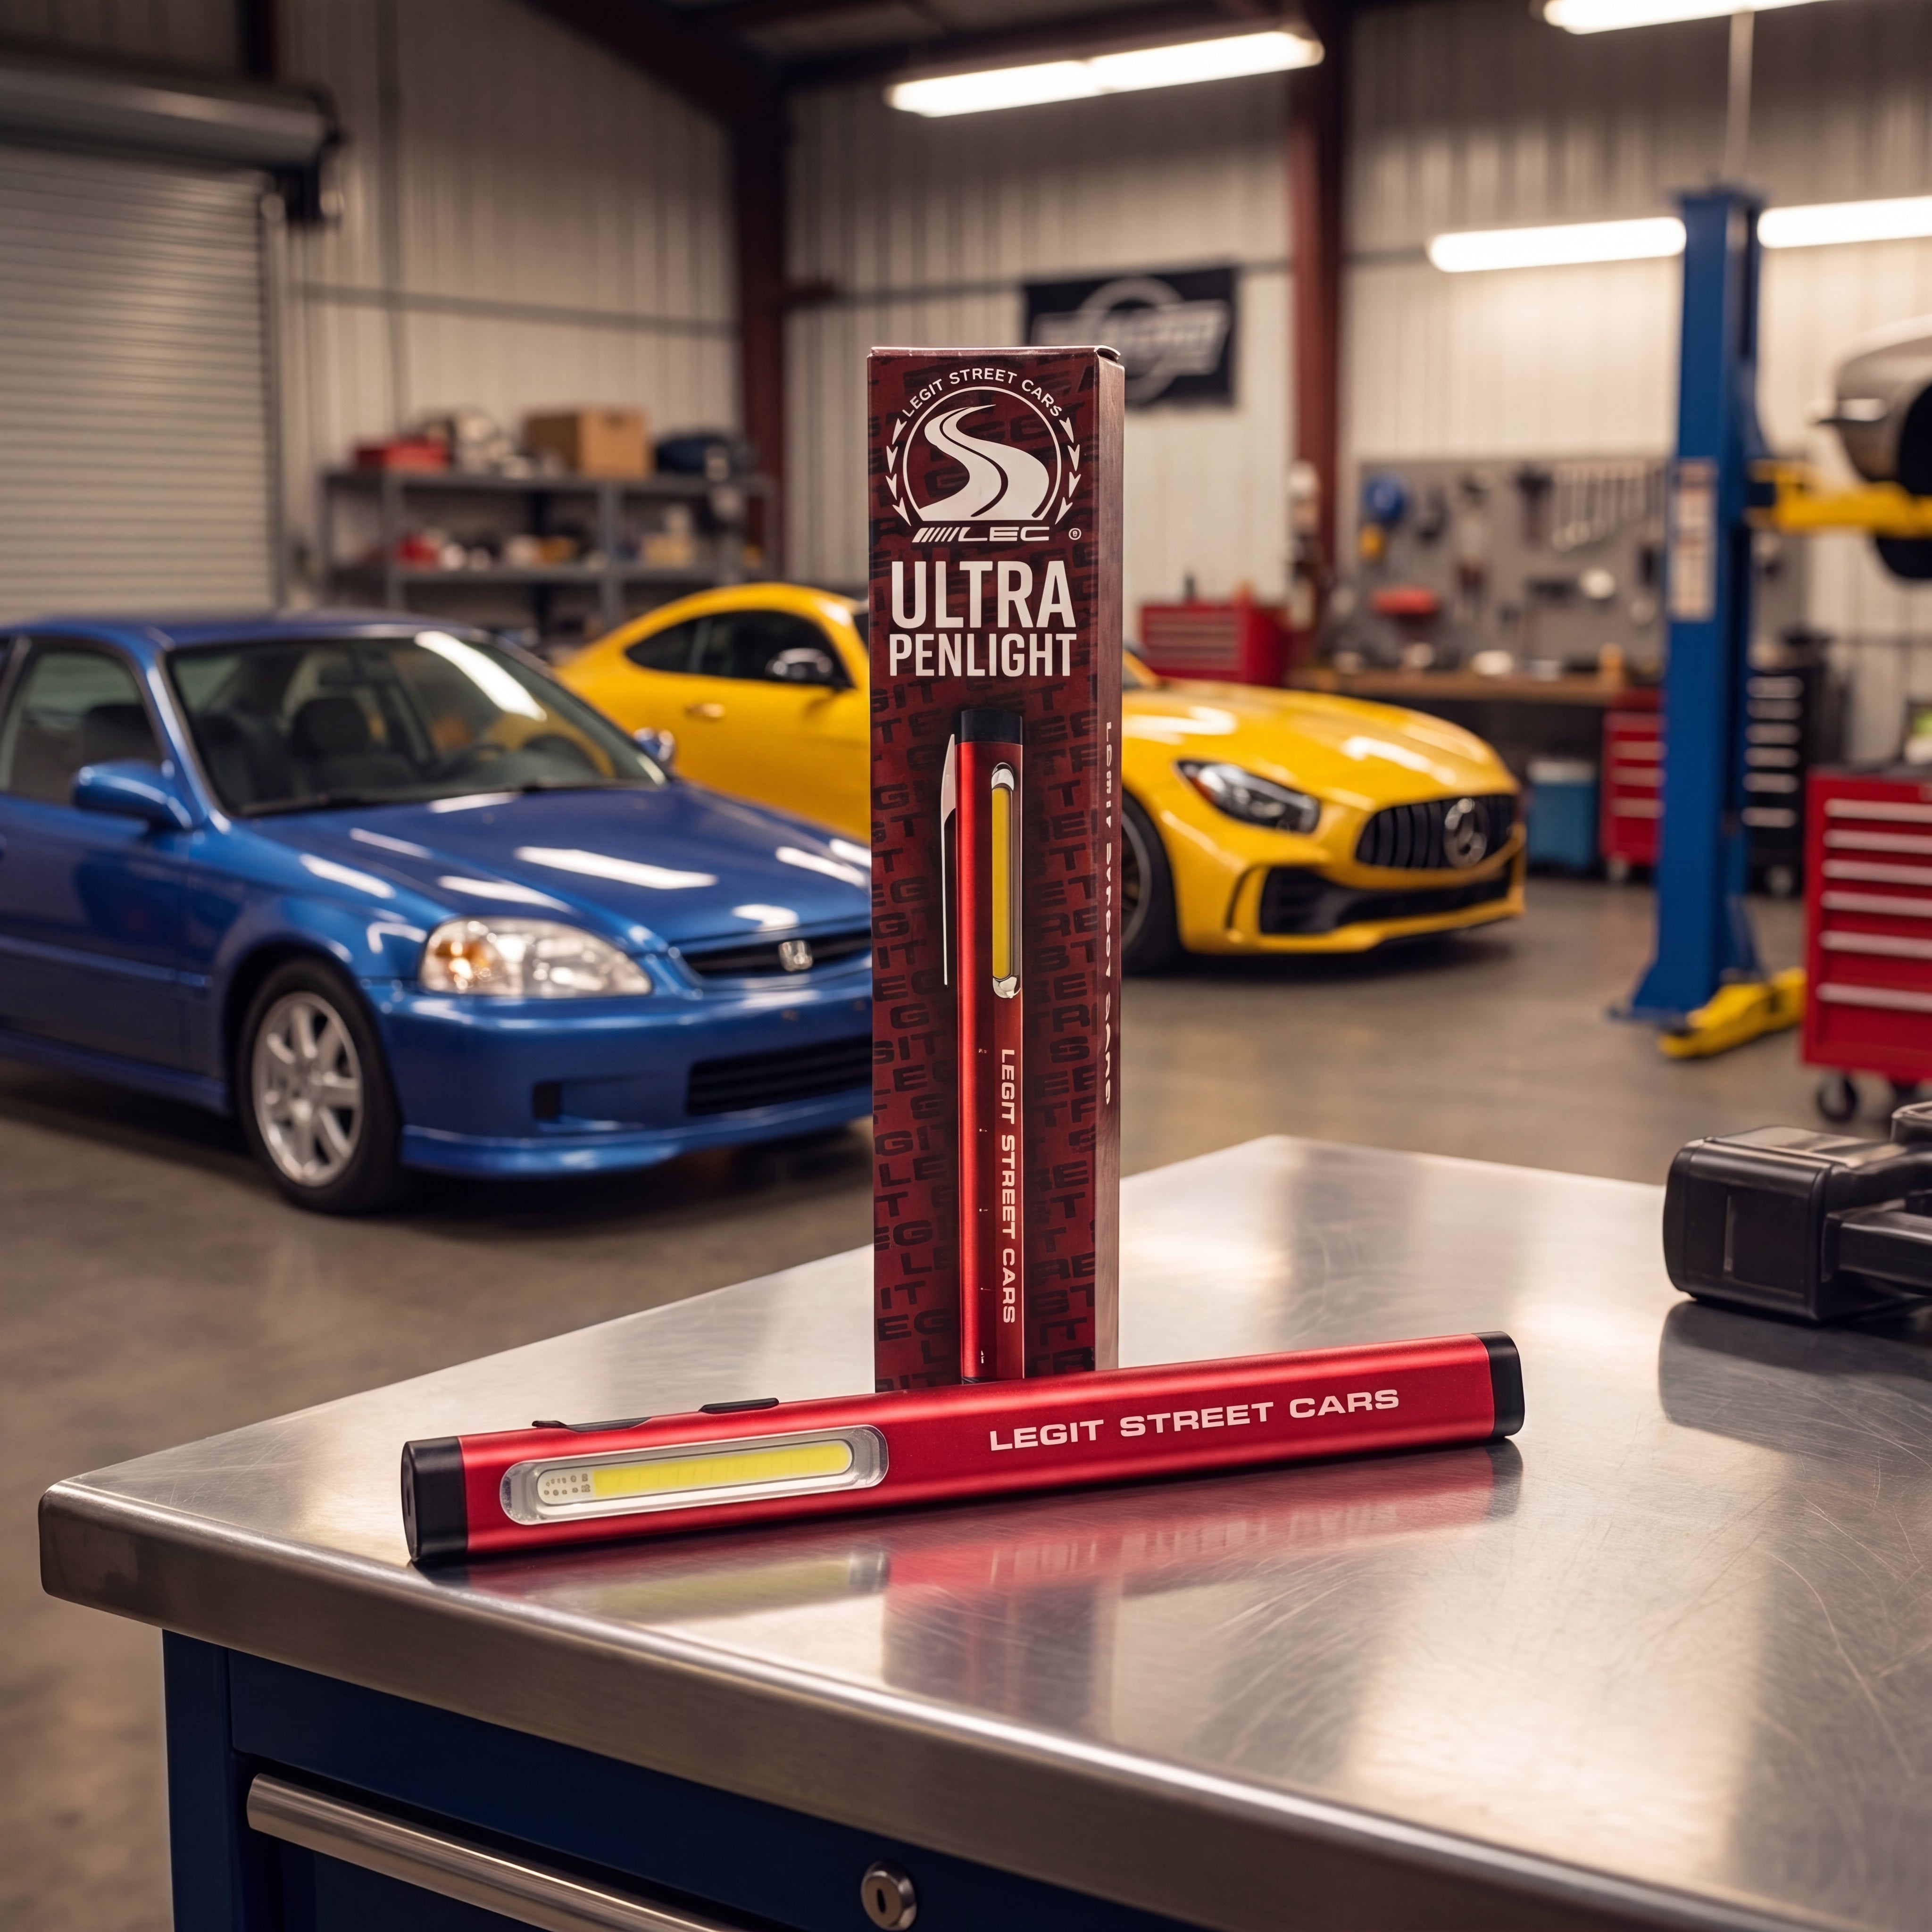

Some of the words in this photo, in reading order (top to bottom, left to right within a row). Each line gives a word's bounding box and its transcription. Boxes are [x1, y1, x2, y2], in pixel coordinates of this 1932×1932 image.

[902, 378, 944, 418] LEGIT
[949, 367, 1018, 385] STREET
[1021, 379, 1063, 417] CARS
[891, 560, 1076, 629] ULTRA
[889, 633, 1077, 677] PENLIGHT
[1001, 1049, 1016, 1124] LEGIT
[1001, 1134, 1016, 1240] STREET
[1002, 1248, 1016, 1324] CARS
[989, 1419, 1105, 1451] LEGIT
[1119, 1401, 1274, 1437] STREET
[1289, 1389, 1399, 1419] CARS
